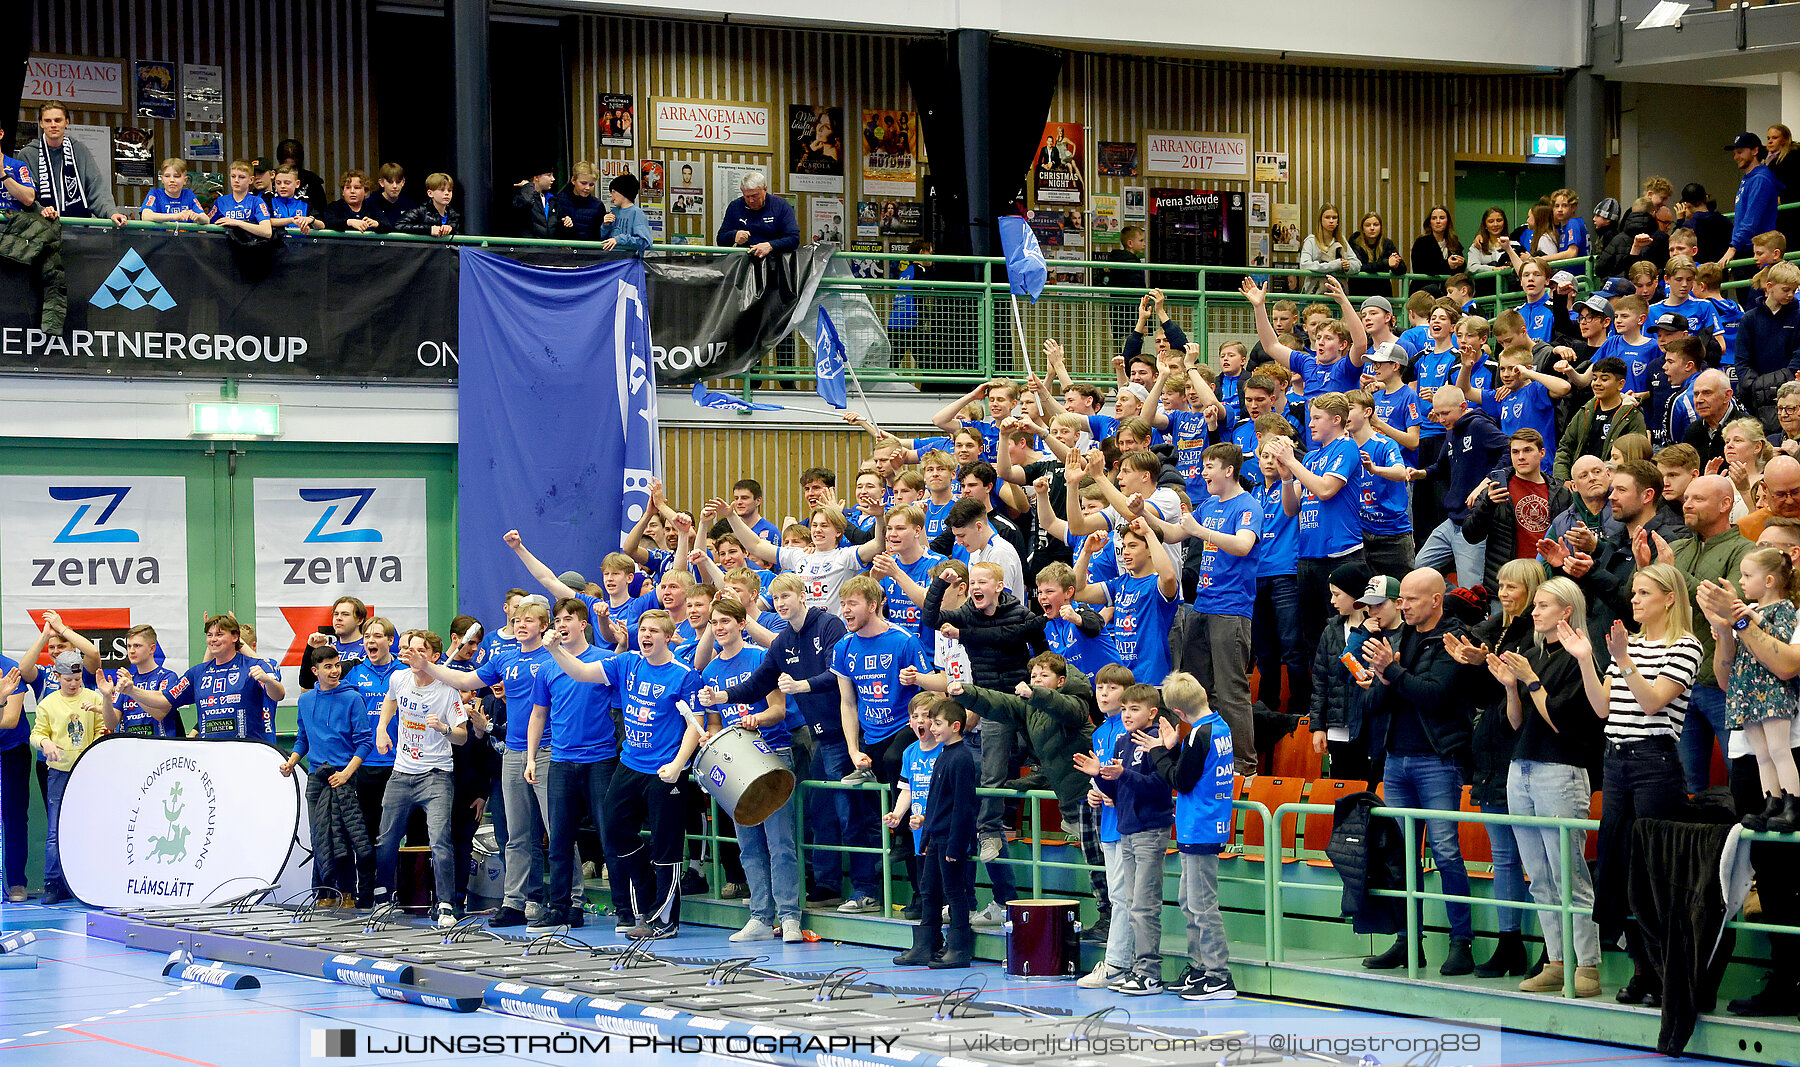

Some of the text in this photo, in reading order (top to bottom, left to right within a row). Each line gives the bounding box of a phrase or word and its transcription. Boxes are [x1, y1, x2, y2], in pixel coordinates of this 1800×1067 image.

[31, 79, 76, 98] 2014
[659, 106, 766, 126] ARRANGEMANG
[694, 123, 732, 142] 2015
[1150, 139, 1244, 156] ARRANGEMANG
[802, 161, 831, 169] CAROLA
[1181, 155, 1213, 170] 2017
[1039, 171, 1079, 181] CHRISTMAS
[1048, 179, 1070, 188] NIGHT
[1155, 194, 1219, 207] Arena Skövde
[1407, 402, 1420, 420] MAXI
[982, 443, 991, 454] 18
[1178, 450, 1202, 462] RAPP
[31, 556, 161, 588] zerva
[283, 555, 402, 585] zerva
[797, 563, 805, 574] 5
[887, 583, 895, 595] 4
[889, 608, 921, 620] DALOC
[504, 665, 519, 680] 14
[848, 660, 856, 673] 9
[170, 677, 190, 699] MAXI
[200, 675, 213, 690] 23
[857, 684, 889, 696] DALOC
[399, 695, 409, 707] 18
[204, 707, 235, 716] VOLVO
[262, 707, 272, 734] DALOC
[625, 724, 653, 743] RAPP
[127, 756, 217, 870] HOTELL KONFERENS RESTAURANG
[126, 875, 194, 898] FLÄMSLÄTT
